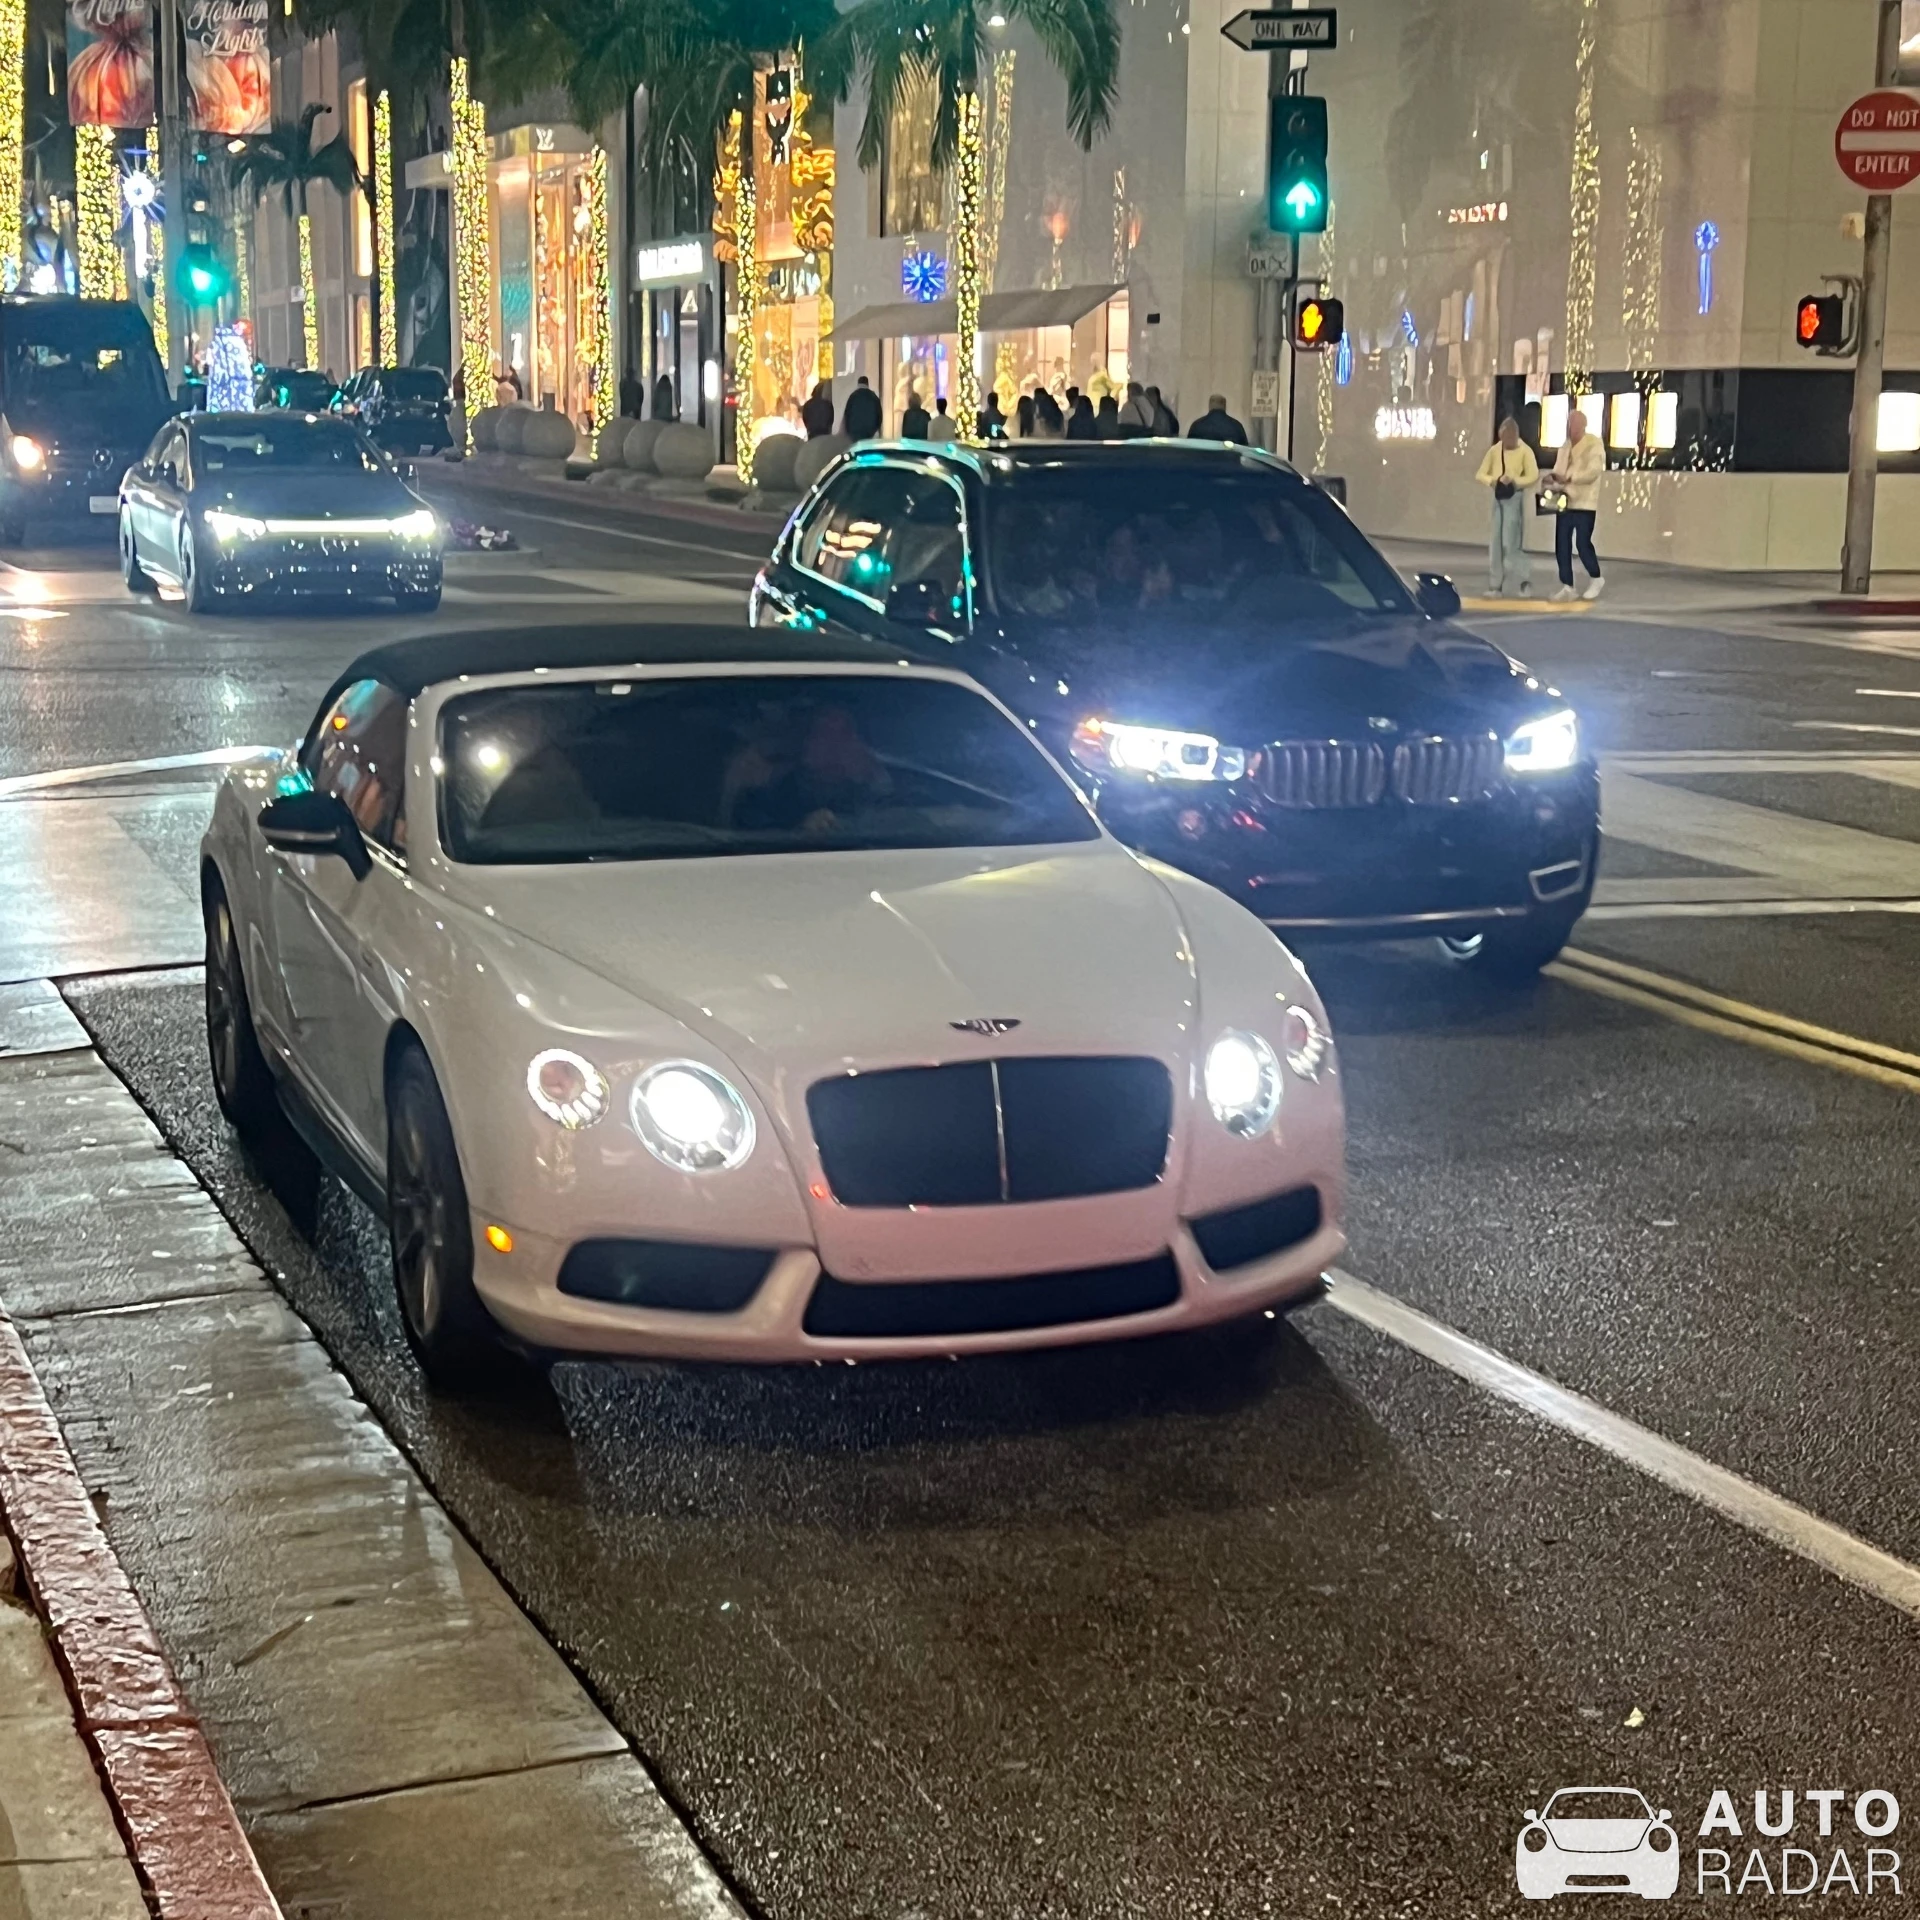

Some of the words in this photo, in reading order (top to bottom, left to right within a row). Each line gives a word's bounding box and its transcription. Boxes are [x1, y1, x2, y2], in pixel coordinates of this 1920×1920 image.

[187, 0, 268, 32] Holiday
[1292, 20, 1323, 38] WAY
[201, 27, 266, 56] Lights
[1851, 108, 1875, 127] DO
[1886, 109, 1919, 127] NOT
[1855, 155, 1909, 174] ENTER
